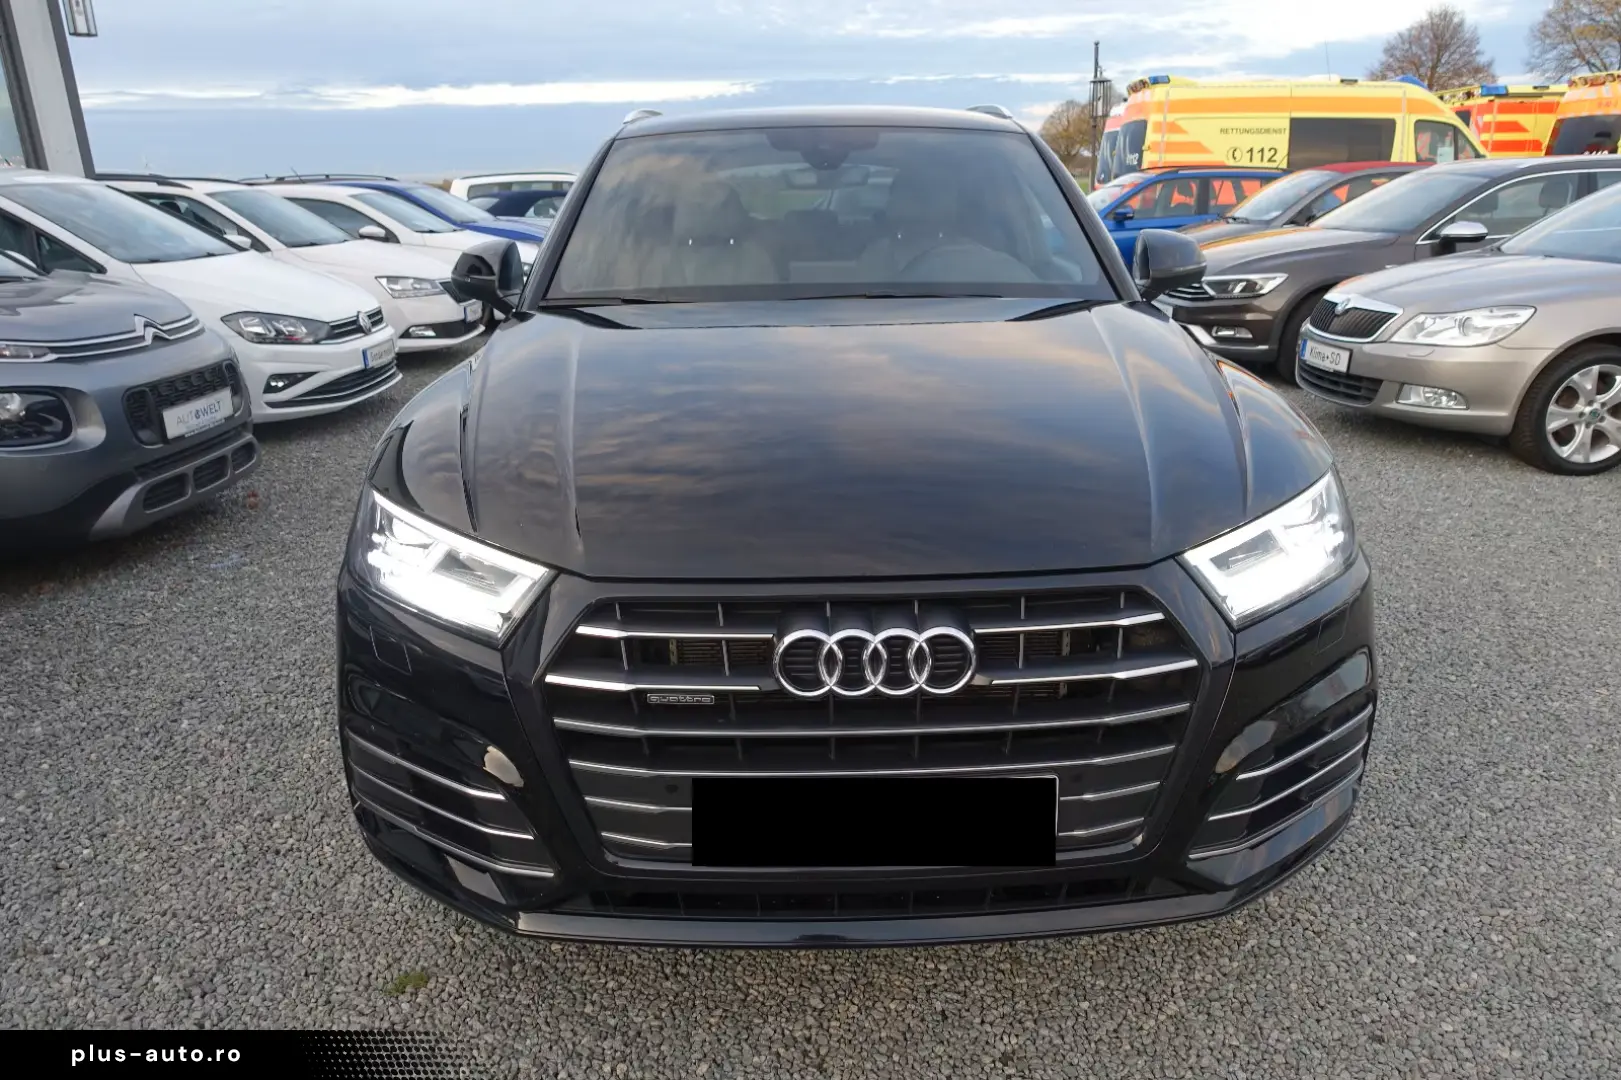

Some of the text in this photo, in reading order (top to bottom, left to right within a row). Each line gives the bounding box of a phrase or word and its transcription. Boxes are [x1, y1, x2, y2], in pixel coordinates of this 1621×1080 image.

[1219, 127, 1287, 135] RETTUNGSDIENST
[1246, 147, 1278, 163] 112
[650, 695, 711, 703] quattro
